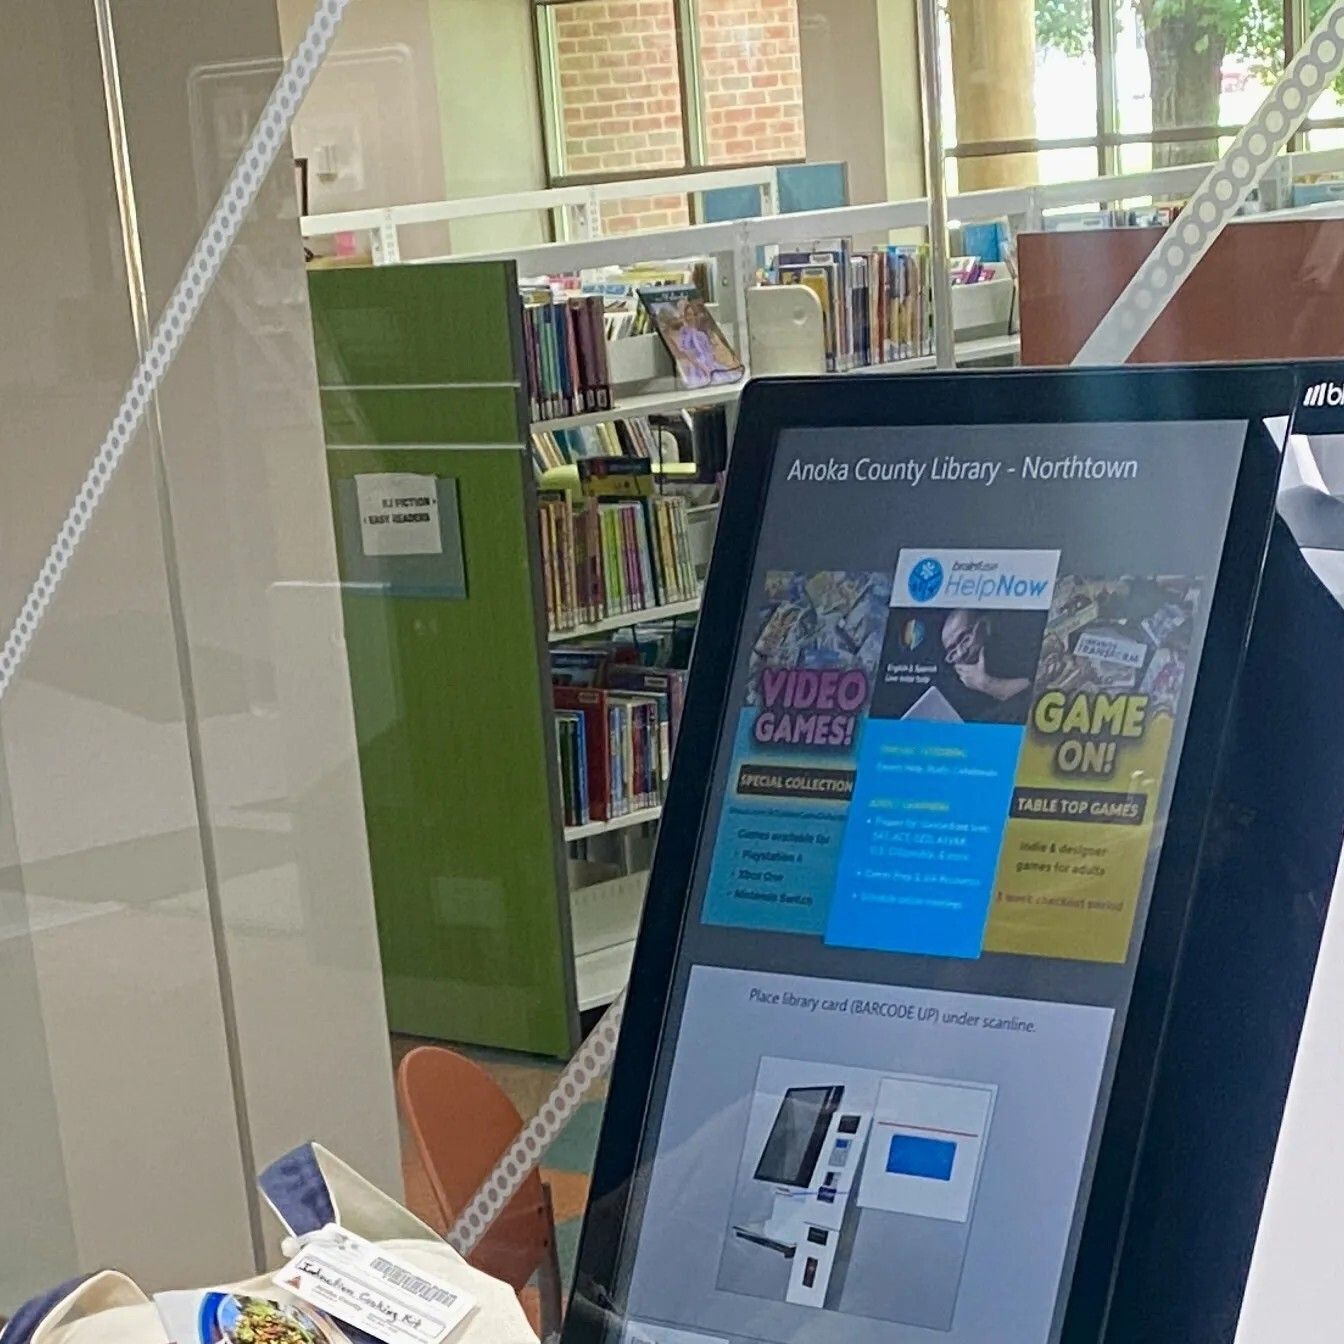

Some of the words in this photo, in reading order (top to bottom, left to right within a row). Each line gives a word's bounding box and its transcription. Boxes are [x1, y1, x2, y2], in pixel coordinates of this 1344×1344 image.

[786, 459, 849, 481] Anoka
[854, 458, 926, 486] County
[930, 456, 1002, 486] Library
[1021, 455, 1138, 480] Northtown
[944, 574, 1049, 601] HelpNow
[762, 668, 867, 712] VIDEO
[755, 712, 856, 745] GAMES!
[1034, 691, 1149, 737] GAME
[1058, 740, 1116, 773] ON!
[740, 774, 784, 789] SPECIAL
[785, 776, 853, 793] COLLECTION
[1017, 797, 1057, 813] TABLE
[1059, 799, 1089, 814] TOP
[1090, 802, 1140, 818] GAMES
[749, 988, 780, 1005] Place
[782, 991, 819, 1013] library
[821, 998, 849, 1013] card
[850, 999, 915, 1021] (BARCODE
[916, 1002, 940, 1024] UP)
[942, 1011, 980, 1028] under
[982, 1014, 1036, 1034] scanline.
